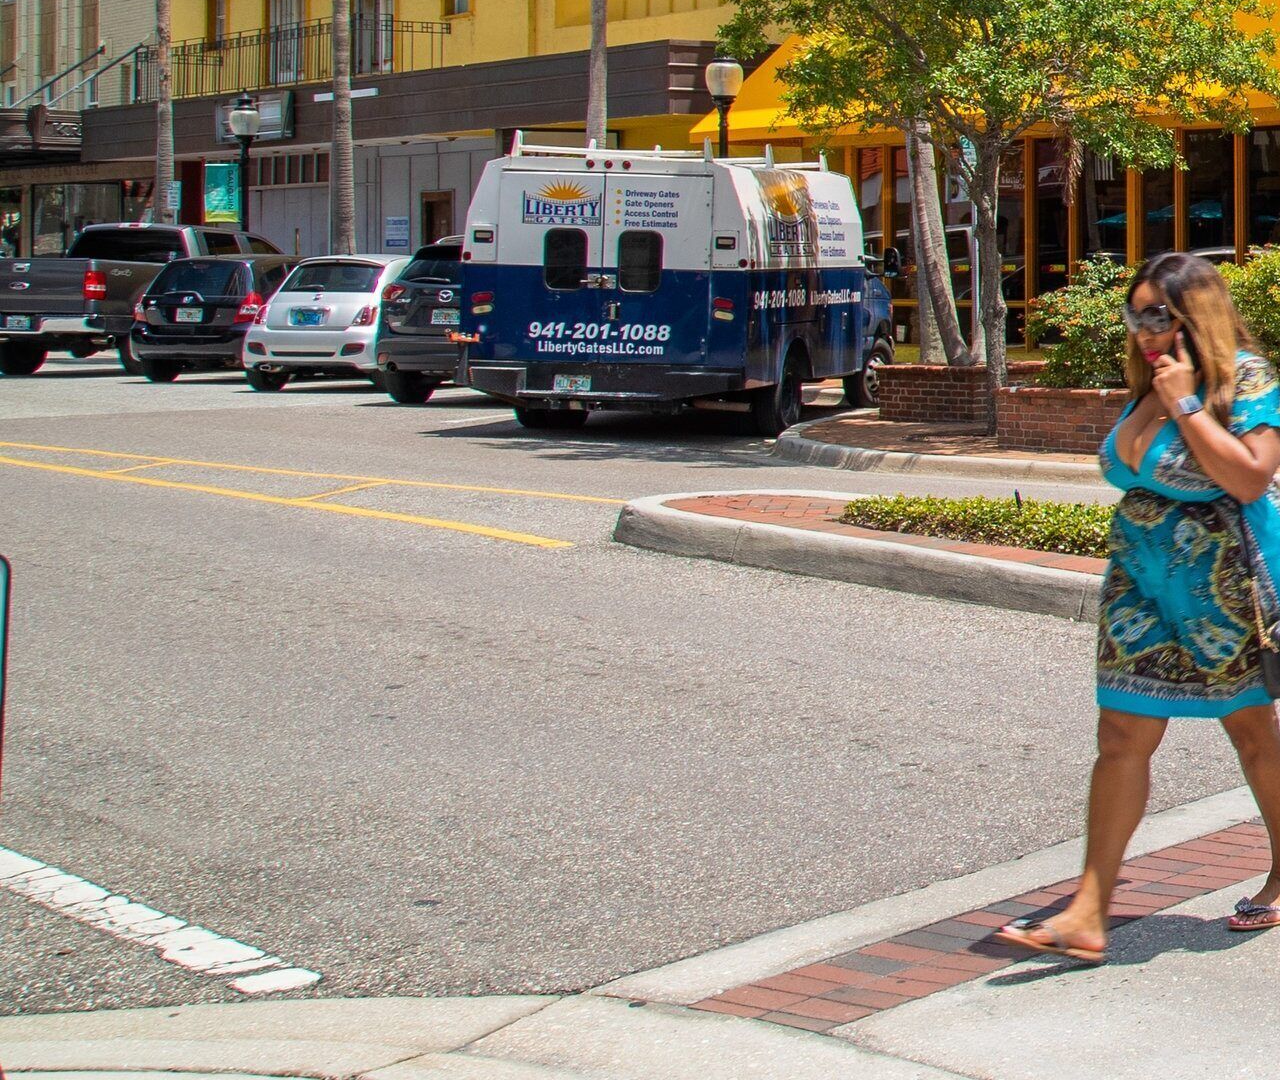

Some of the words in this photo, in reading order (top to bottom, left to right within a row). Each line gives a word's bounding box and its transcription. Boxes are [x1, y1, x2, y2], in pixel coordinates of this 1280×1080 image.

[625, 189, 657, 200] Driveway
[658, 190, 680, 199] Gates
[525, 199, 600, 216] LIBERTY
[624, 199, 643, 208] Gate
[644, 200, 674, 210] Openers
[624, 209, 650, 218] Access
[651, 210, 679, 219] Control
[535, 217, 589, 225] GATES
[624, 219, 641, 228] Free
[642, 220, 678, 229] Estimates
[768, 215, 811, 242] LIBERTY
[754, 289, 807, 310] 941-201-1088
[528, 321, 672, 341] 941-201-1088
[537, 340, 664, 356] LibertyGatesLLC.com
